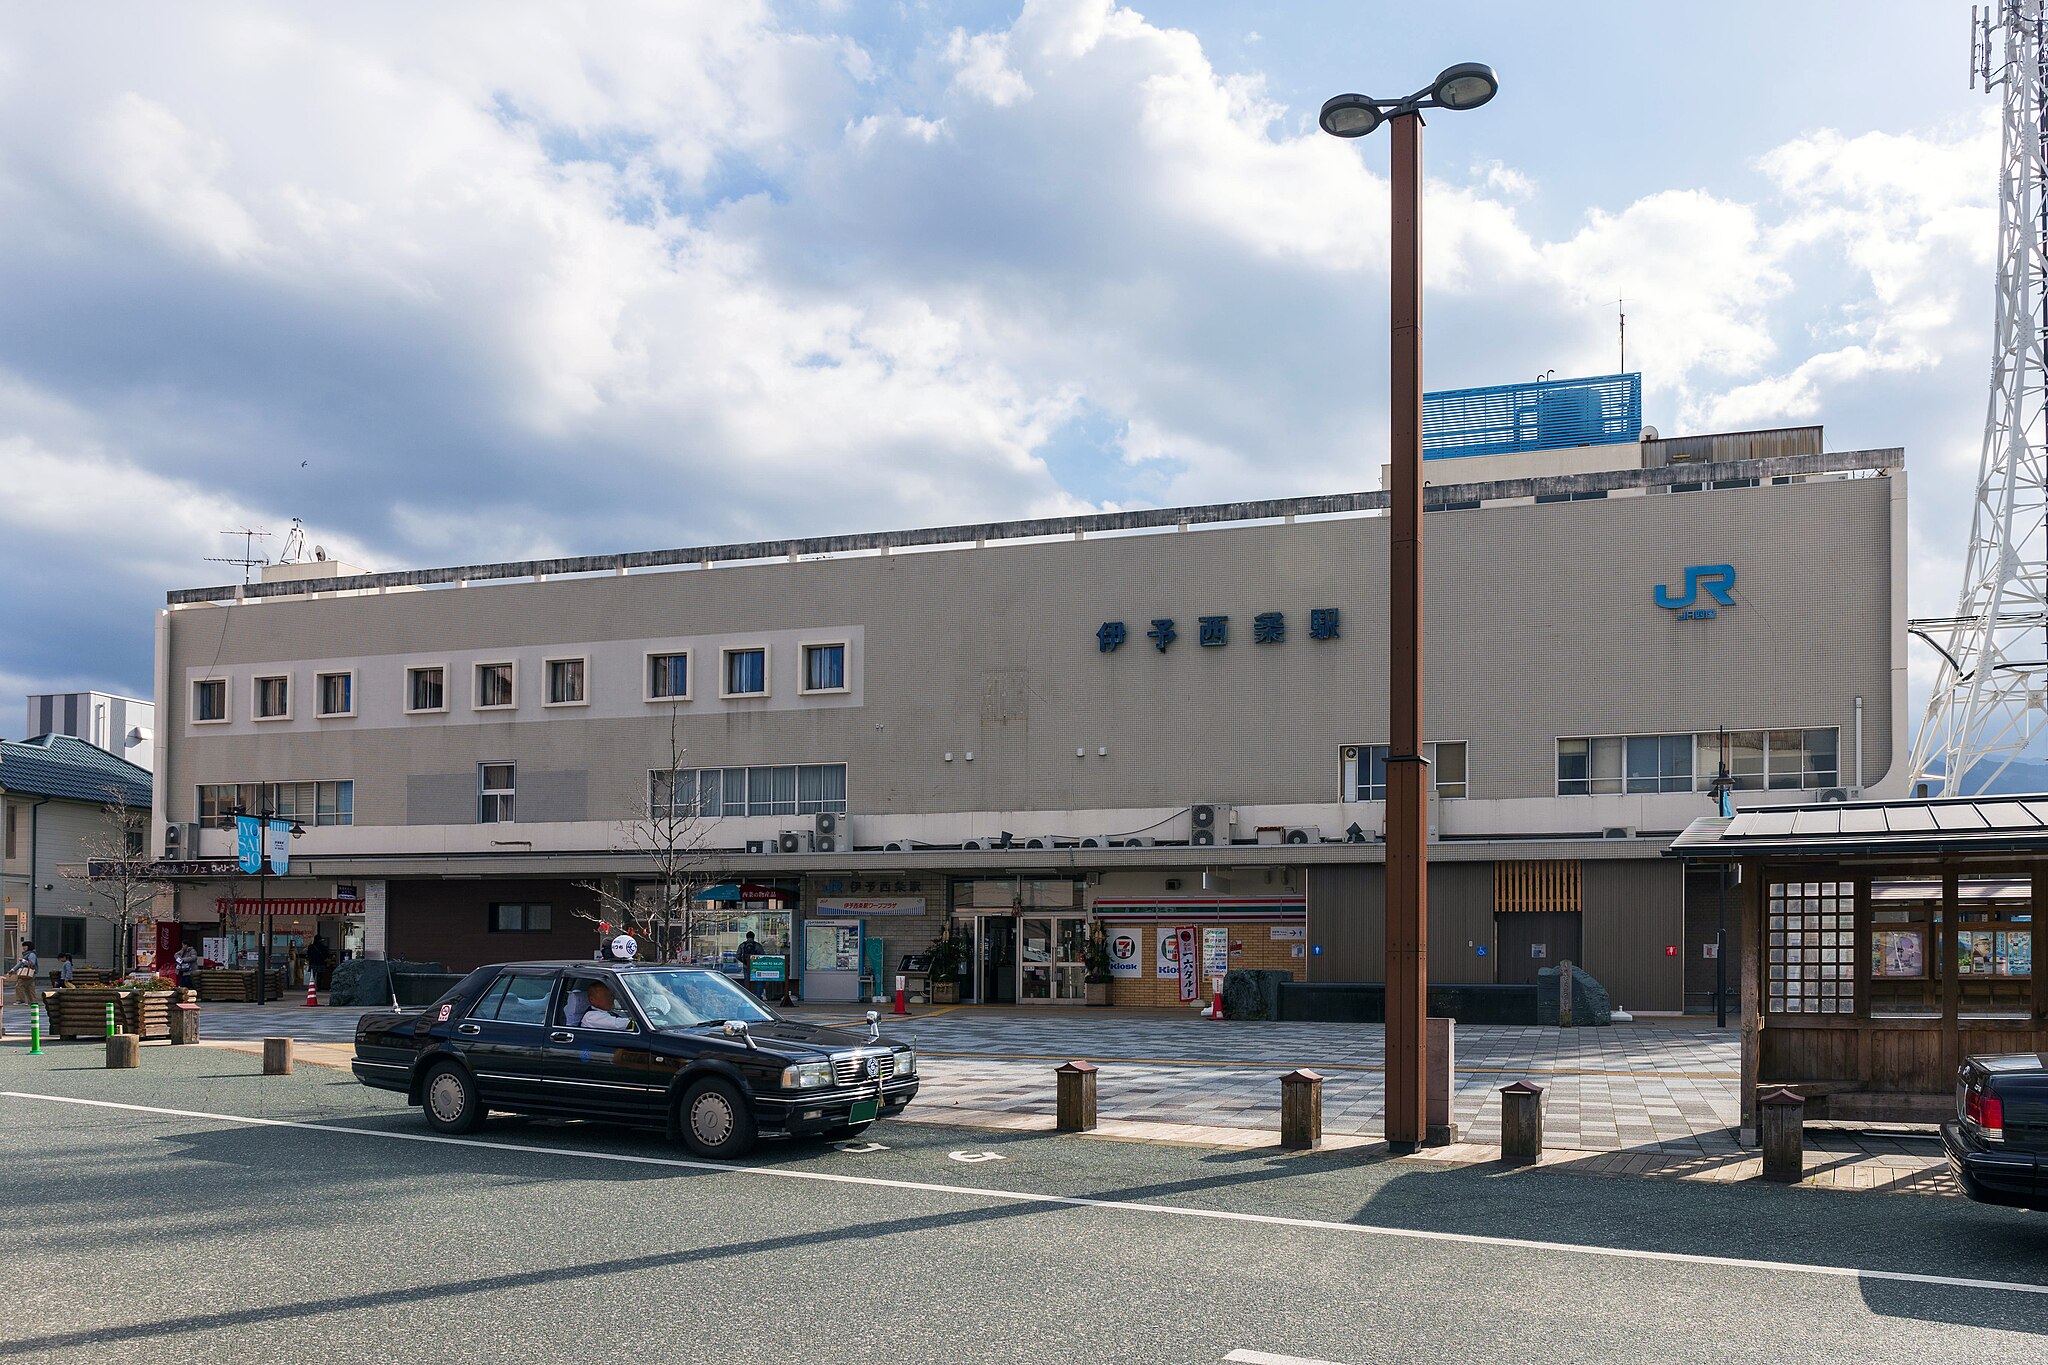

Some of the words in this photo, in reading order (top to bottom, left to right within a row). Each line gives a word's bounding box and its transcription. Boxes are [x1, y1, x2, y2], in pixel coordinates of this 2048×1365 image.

[1655, 564, 1736, 609] JR
[1096, 608, 1341, 653] 伊予西条駅
[238, 821, 260, 837] IYO
[238, 837, 260, 852] SAI
[245, 852, 262, 867] JO
[822, 880, 843, 894] JR
[850, 881, 921, 893] 伊予西条駅
[1110, 962, 1137, 970] Kiosk
[1182, 952, 1194, 998] 一六タルト
